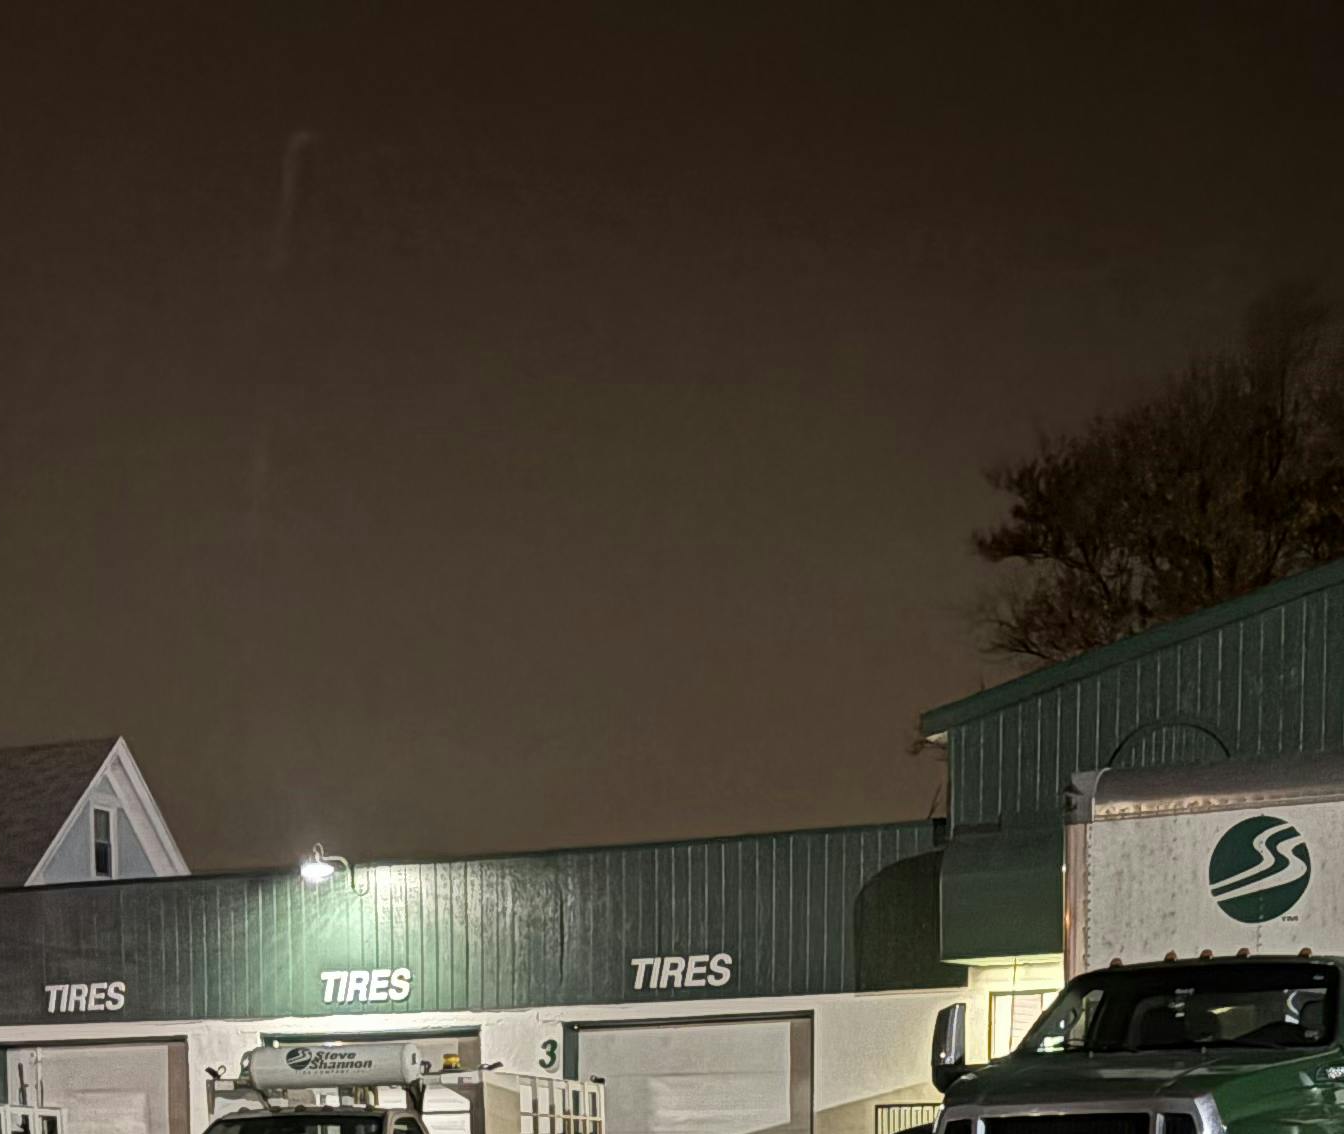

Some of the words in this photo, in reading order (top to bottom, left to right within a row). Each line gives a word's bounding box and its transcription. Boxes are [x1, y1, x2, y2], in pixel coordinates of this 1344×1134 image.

[320, 968, 412, 1004] TIRES
[630, 952, 733, 990] TIRES
[44, 981, 126, 1013] TIRES
[309, 1059, 373, 1070] Shannon
[316, 1051, 357, 1060] Steve
[538, 1039, 558, 1069] 3
